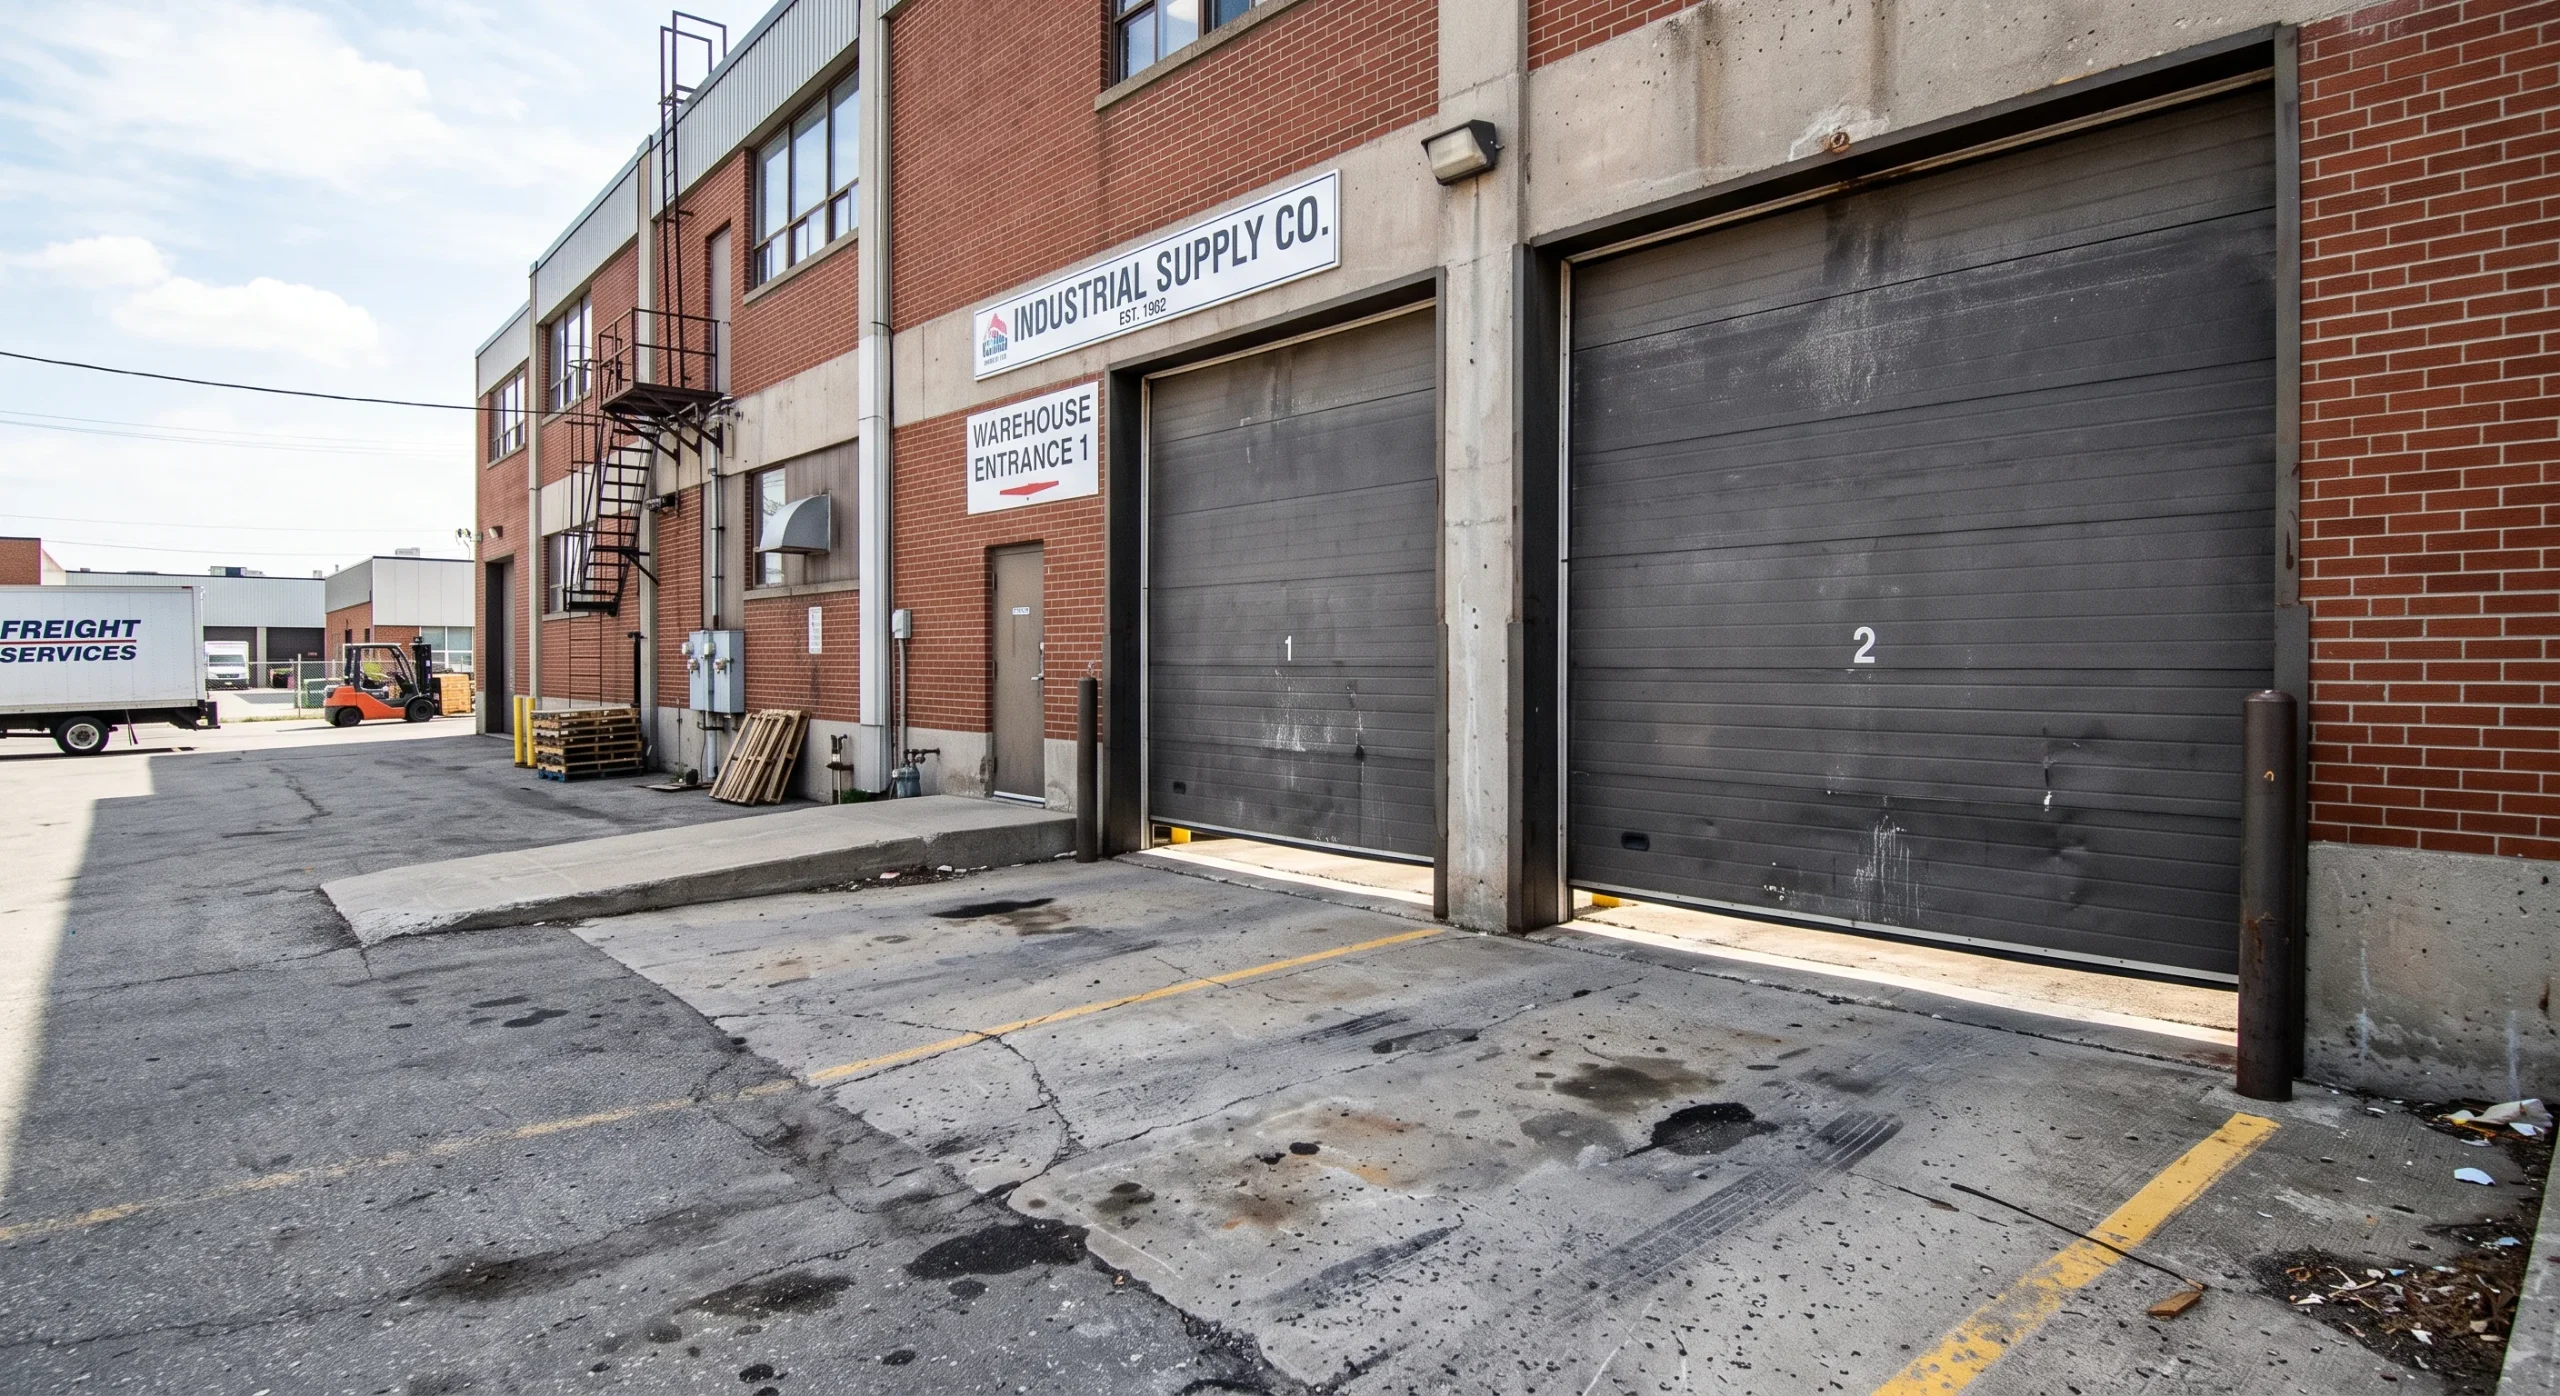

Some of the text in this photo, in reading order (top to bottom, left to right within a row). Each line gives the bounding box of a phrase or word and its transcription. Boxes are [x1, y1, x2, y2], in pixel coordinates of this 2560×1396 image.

[1014, 195, 1329, 342] INDUSTRIAL SUPPLY CO.
[1119, 297, 1167, 326] EST. 1962
[973, 394, 1091, 448] WAREHOUSE
[975, 434, 1088, 482] ENTRANCE 1
[0, 619, 141, 639] FREIGHT
[1853, 626, 1876, 664] 2
[0, 645, 137, 663] SERVICES
[1284, 635, 1292, 662] 1
